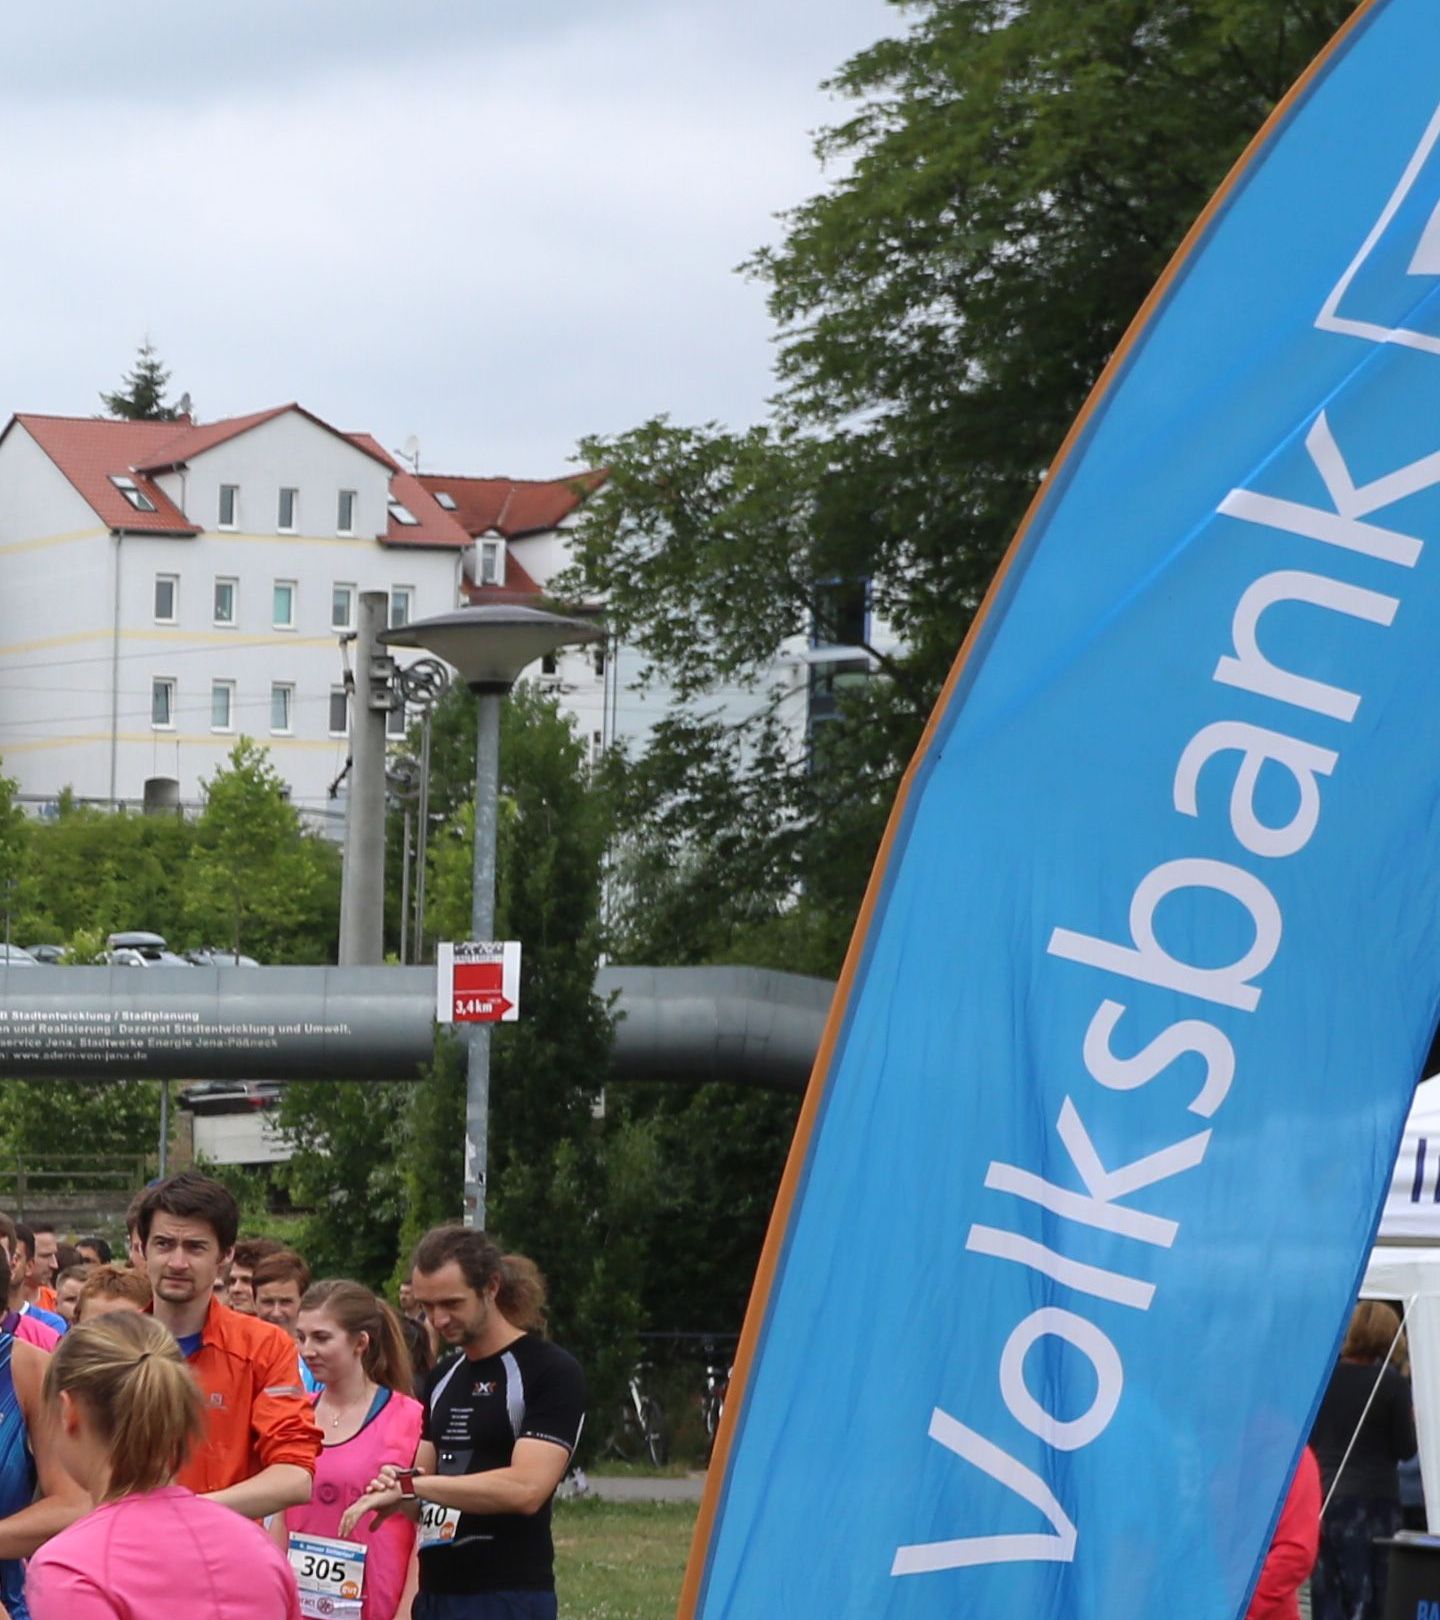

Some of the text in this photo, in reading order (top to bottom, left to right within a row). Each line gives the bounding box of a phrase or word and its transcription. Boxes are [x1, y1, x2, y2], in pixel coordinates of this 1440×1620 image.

[890, 409, 1440, 1575] Volksbank
[455, 999, 493, 1015] 3,4 km
[12, 1010, 111, 1023] Stadtentwicklung
[122, 1010, 199, 1023] Stadtplanung
[13, 1024, 36, 1035] und
[119, 1025, 170, 1035] Dezernat
[174, 1024, 275, 1036] Stadtentwicklung
[279, 1024, 301, 1034] und
[80, 1037, 144, 1048] Stadtwerke
[148, 1038, 192, 1050] Energie
[420, 1507, 448, 1529] 40
[300, 1555, 346, 1582] 305
